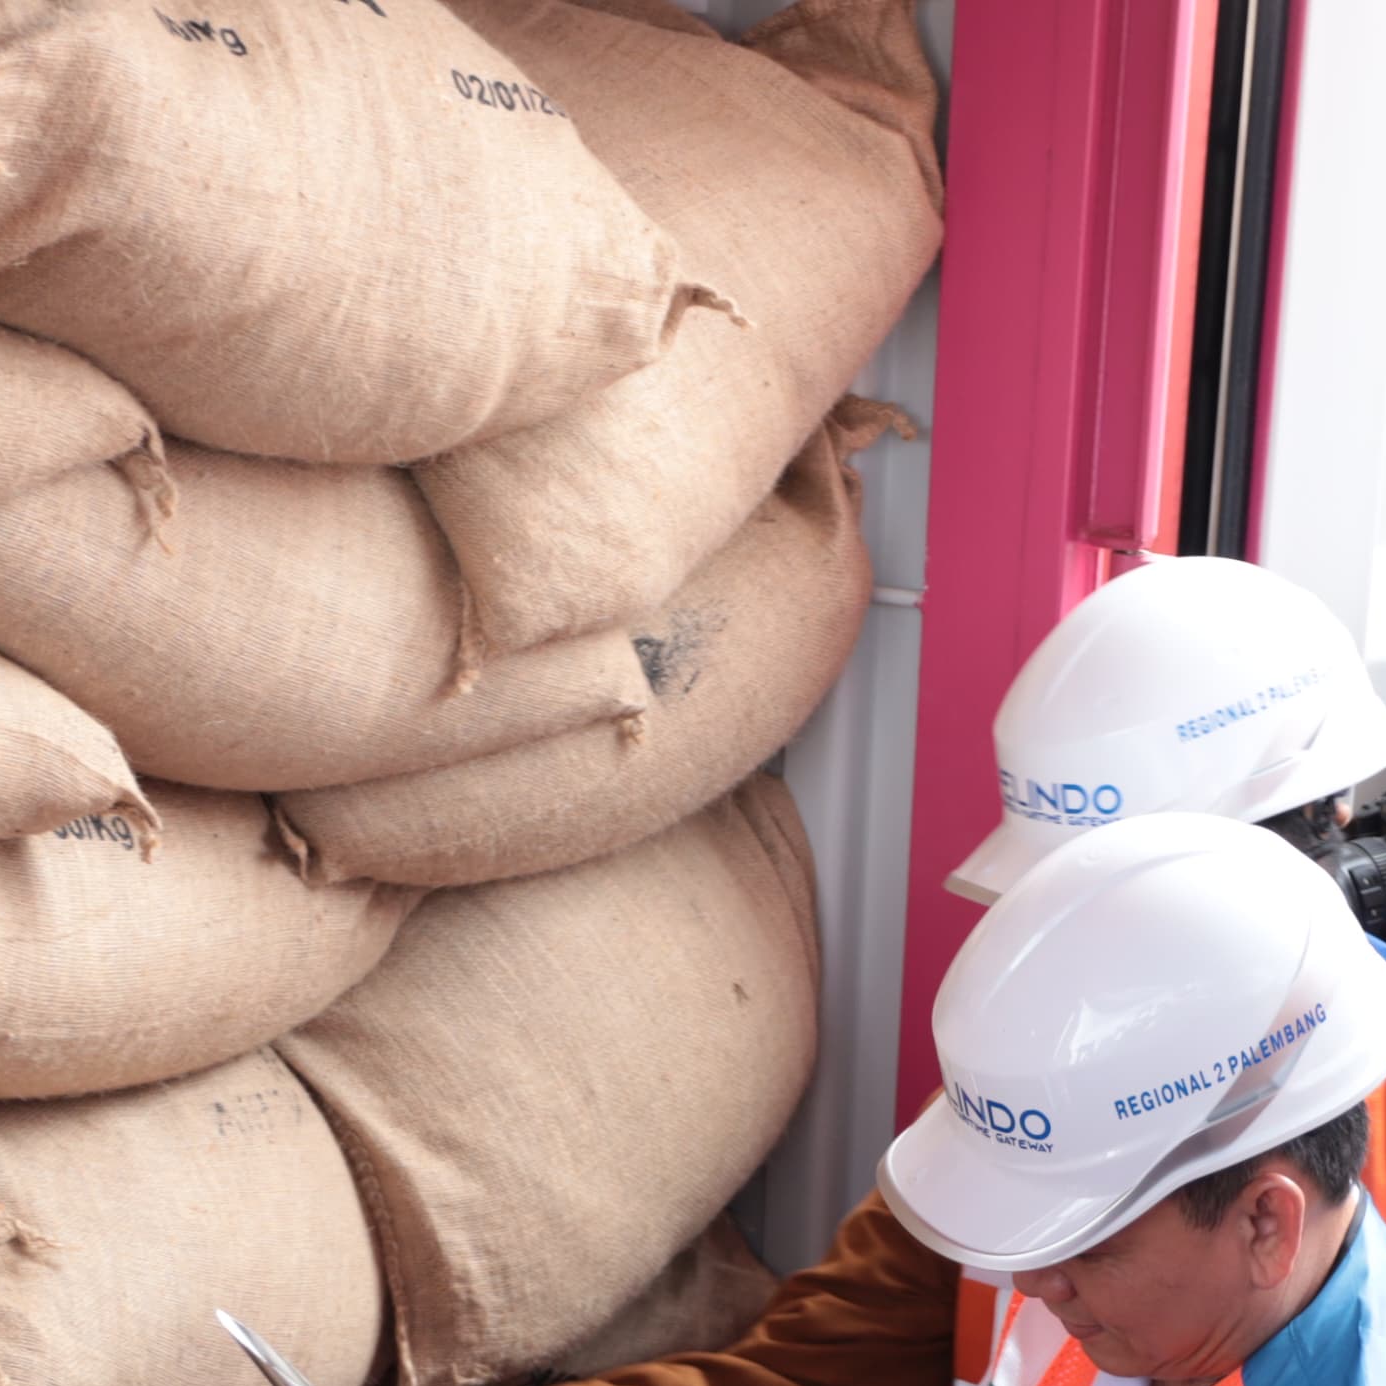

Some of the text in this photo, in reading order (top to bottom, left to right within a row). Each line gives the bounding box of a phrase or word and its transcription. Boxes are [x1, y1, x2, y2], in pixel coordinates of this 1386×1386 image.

[1114, 1002, 1328, 1121] REGIONAL 2 PALEMBANG
[995, 1132, 1054, 1154] GATEWAY
